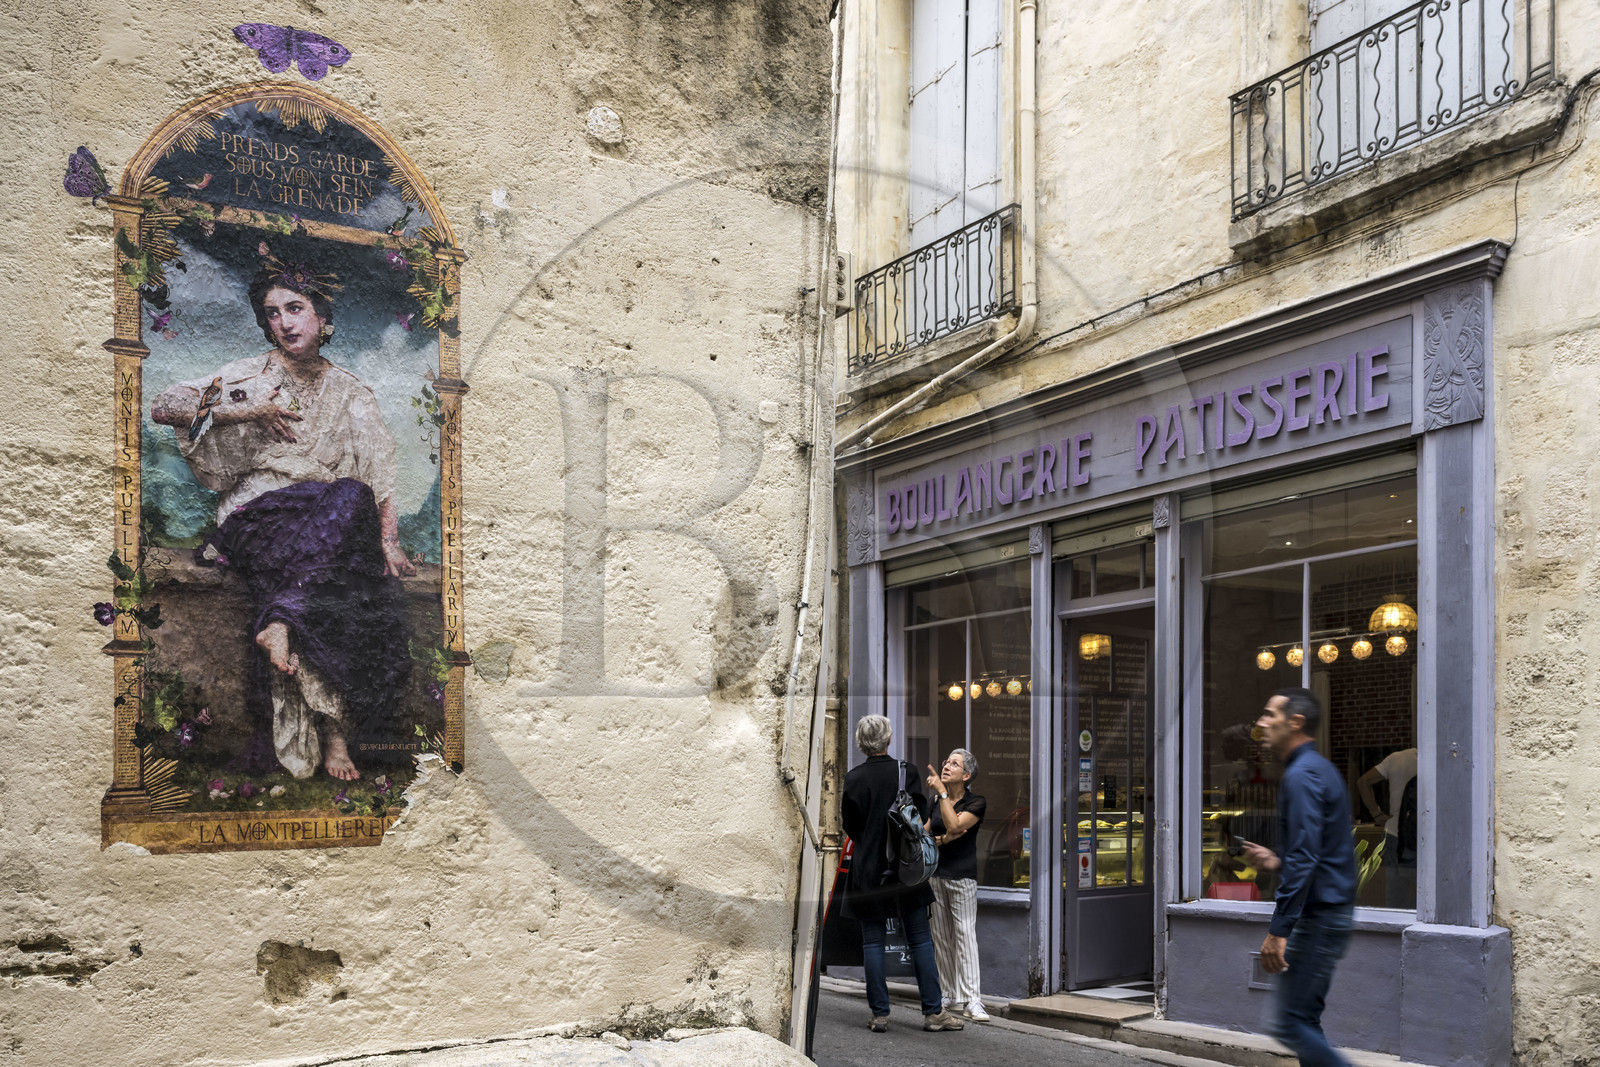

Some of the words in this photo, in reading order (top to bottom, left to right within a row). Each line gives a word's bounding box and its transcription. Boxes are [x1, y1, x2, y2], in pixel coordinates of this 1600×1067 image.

[221, 131, 299, 164] PRENDS
[225, 152, 276, 180] SOUS
[280, 165, 321, 189] MON
[235, 176, 262, 199] LA
[270, 183, 364, 217] GRENADE
[121, 371, 133, 462] MONTIS
[446, 409, 457, 490] MONTIS
[886, 431, 1093, 535] BOULANGERIE
[1134, 343, 1391, 472] PATISSERIE
[121, 475, 134, 635] PUELLM
[446, 501, 459, 644] PUELLARUM
[200, 823, 227, 843] LA
